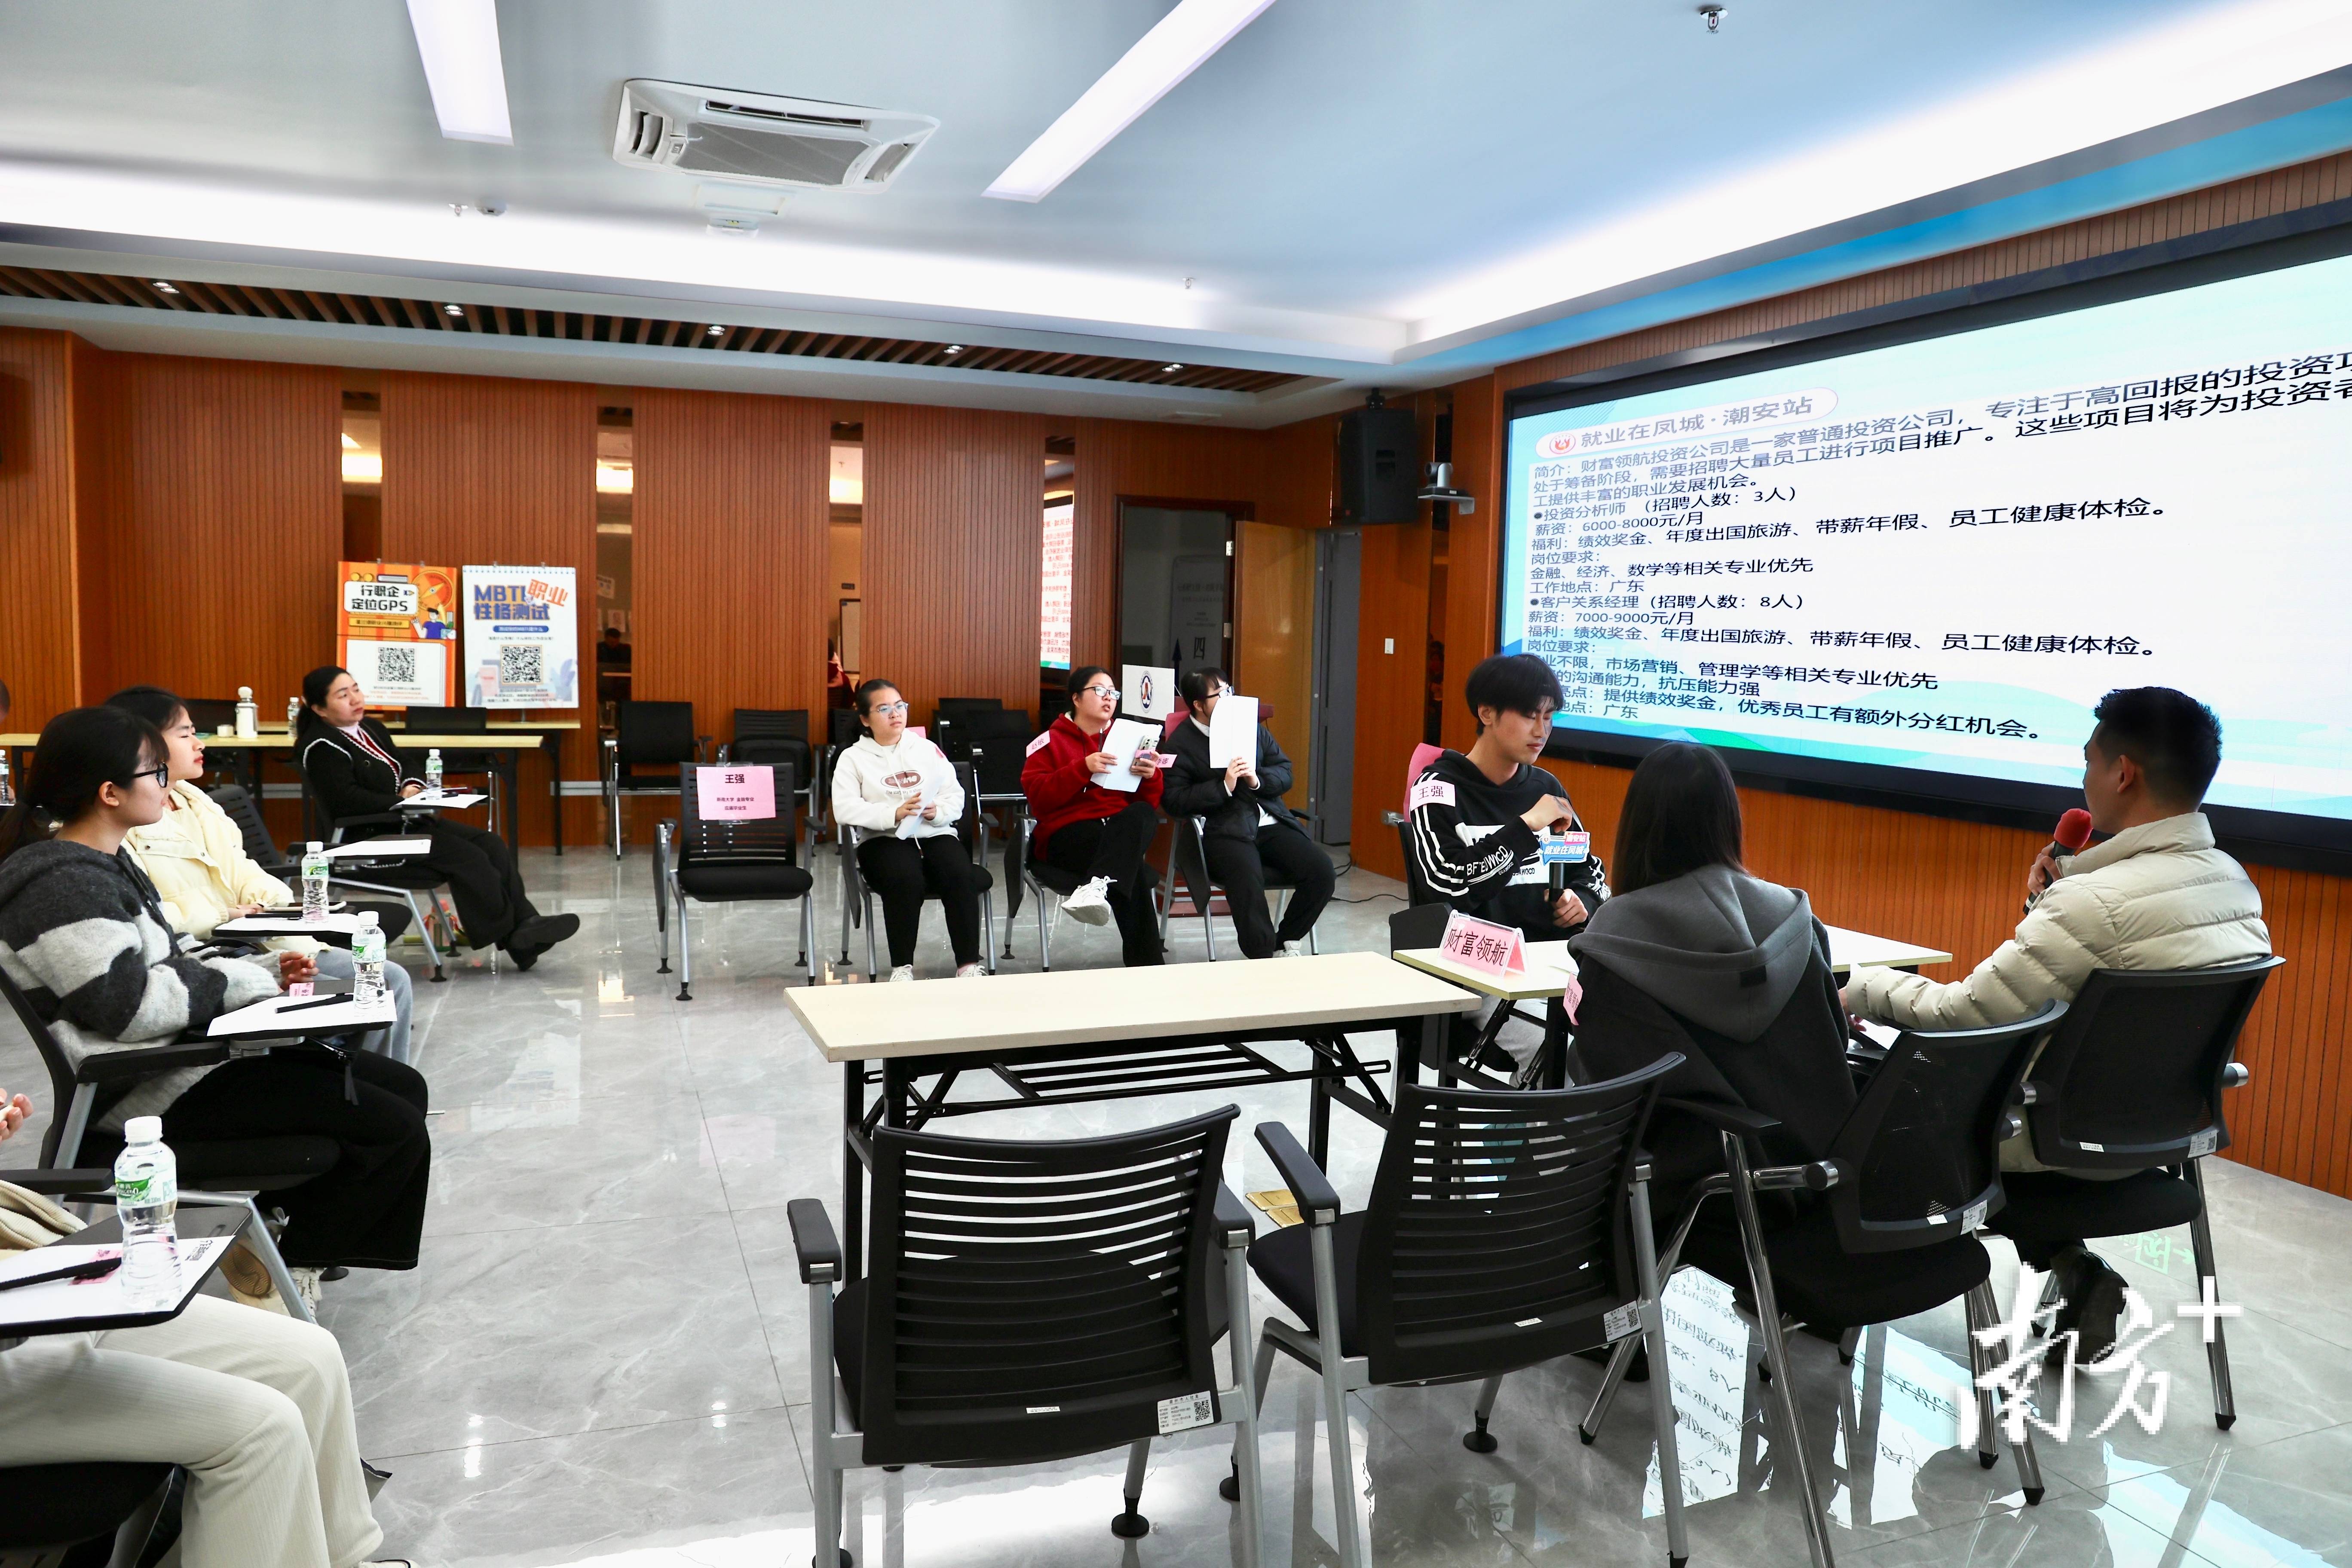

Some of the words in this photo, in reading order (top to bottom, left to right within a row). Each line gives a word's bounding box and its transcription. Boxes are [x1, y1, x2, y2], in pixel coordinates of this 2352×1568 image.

[1531, 551, 1600, 565] 岗位要求：
[361, 585, 399, 597] 行职企
[475, 585, 526, 602] MBTI
[527, 579, 568, 606] 职业
[352, 598, 408, 611] 定位GPS
[474, 603, 550, 620] 性格测试
[1528, 640, 1595, 653] 岗位要求：
[1534, 654, 1938, 690] 业不限，市场营销、管理学等相关专业优先
[1553, 669, 1760, 697] 的沟通能力，抗压能力强
[725, 774, 745, 783] 王强
[1418, 785, 1444, 800] 王强
[1544, 845, 1585, 855] 就业在凤城
[1444, 928, 1508, 966] 财富领航
